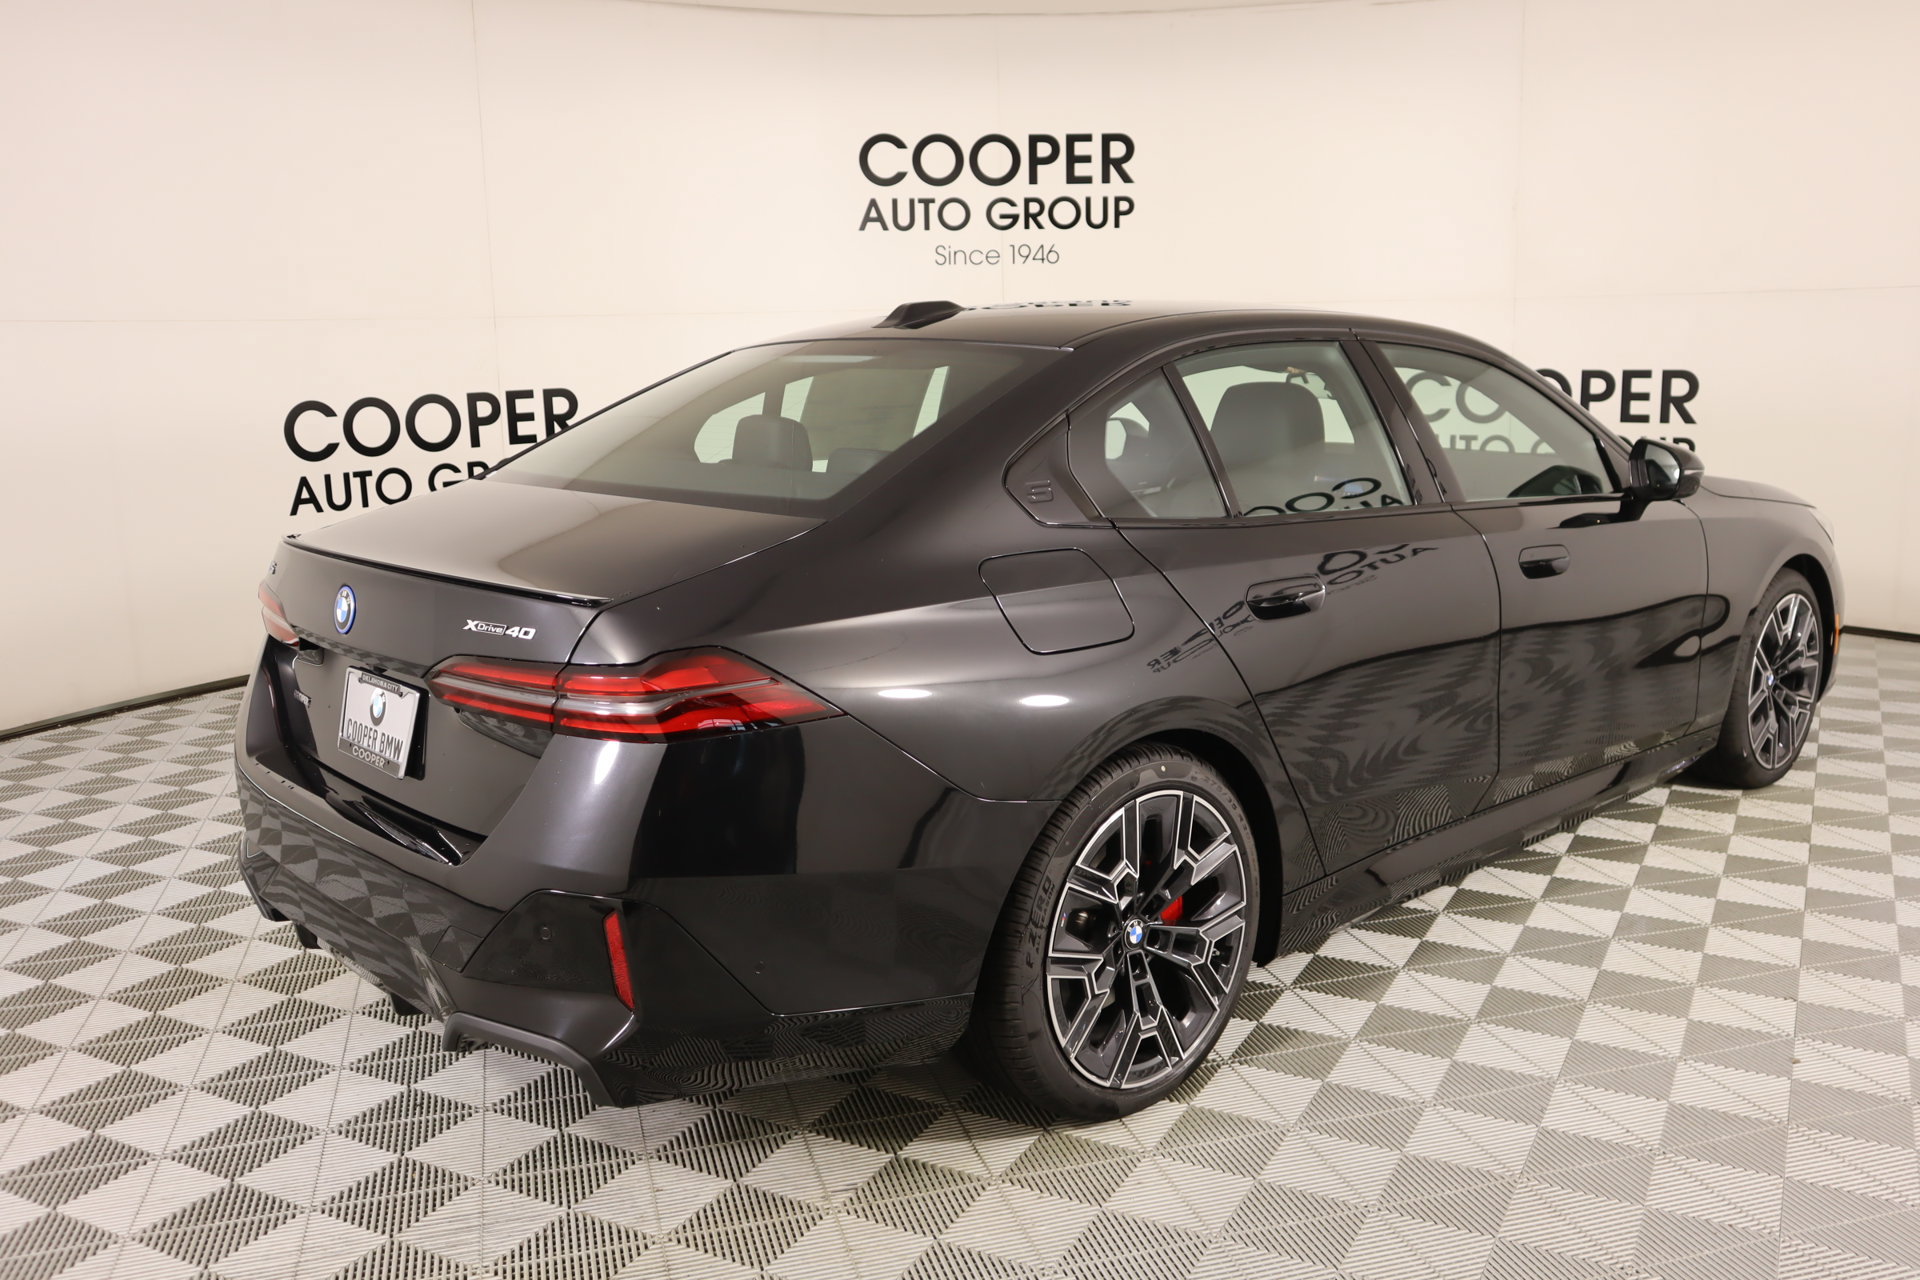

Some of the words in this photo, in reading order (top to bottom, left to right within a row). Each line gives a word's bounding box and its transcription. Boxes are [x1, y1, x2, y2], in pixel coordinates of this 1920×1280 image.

[859, 133, 1135, 187] COOPER
[859, 197, 971, 231] AUTO
[986, 196, 1135, 231] GROUP
[935, 244, 1000, 265] Since
[1009, 244, 1060, 265] 1946
[284, 388, 579, 462] COOPER
[290, 467, 412, 516] AUTO
[347, 718, 379, 748] COOPER
[379, 732, 405, 760] BMW
[352, 745, 387, 769] COOPER
